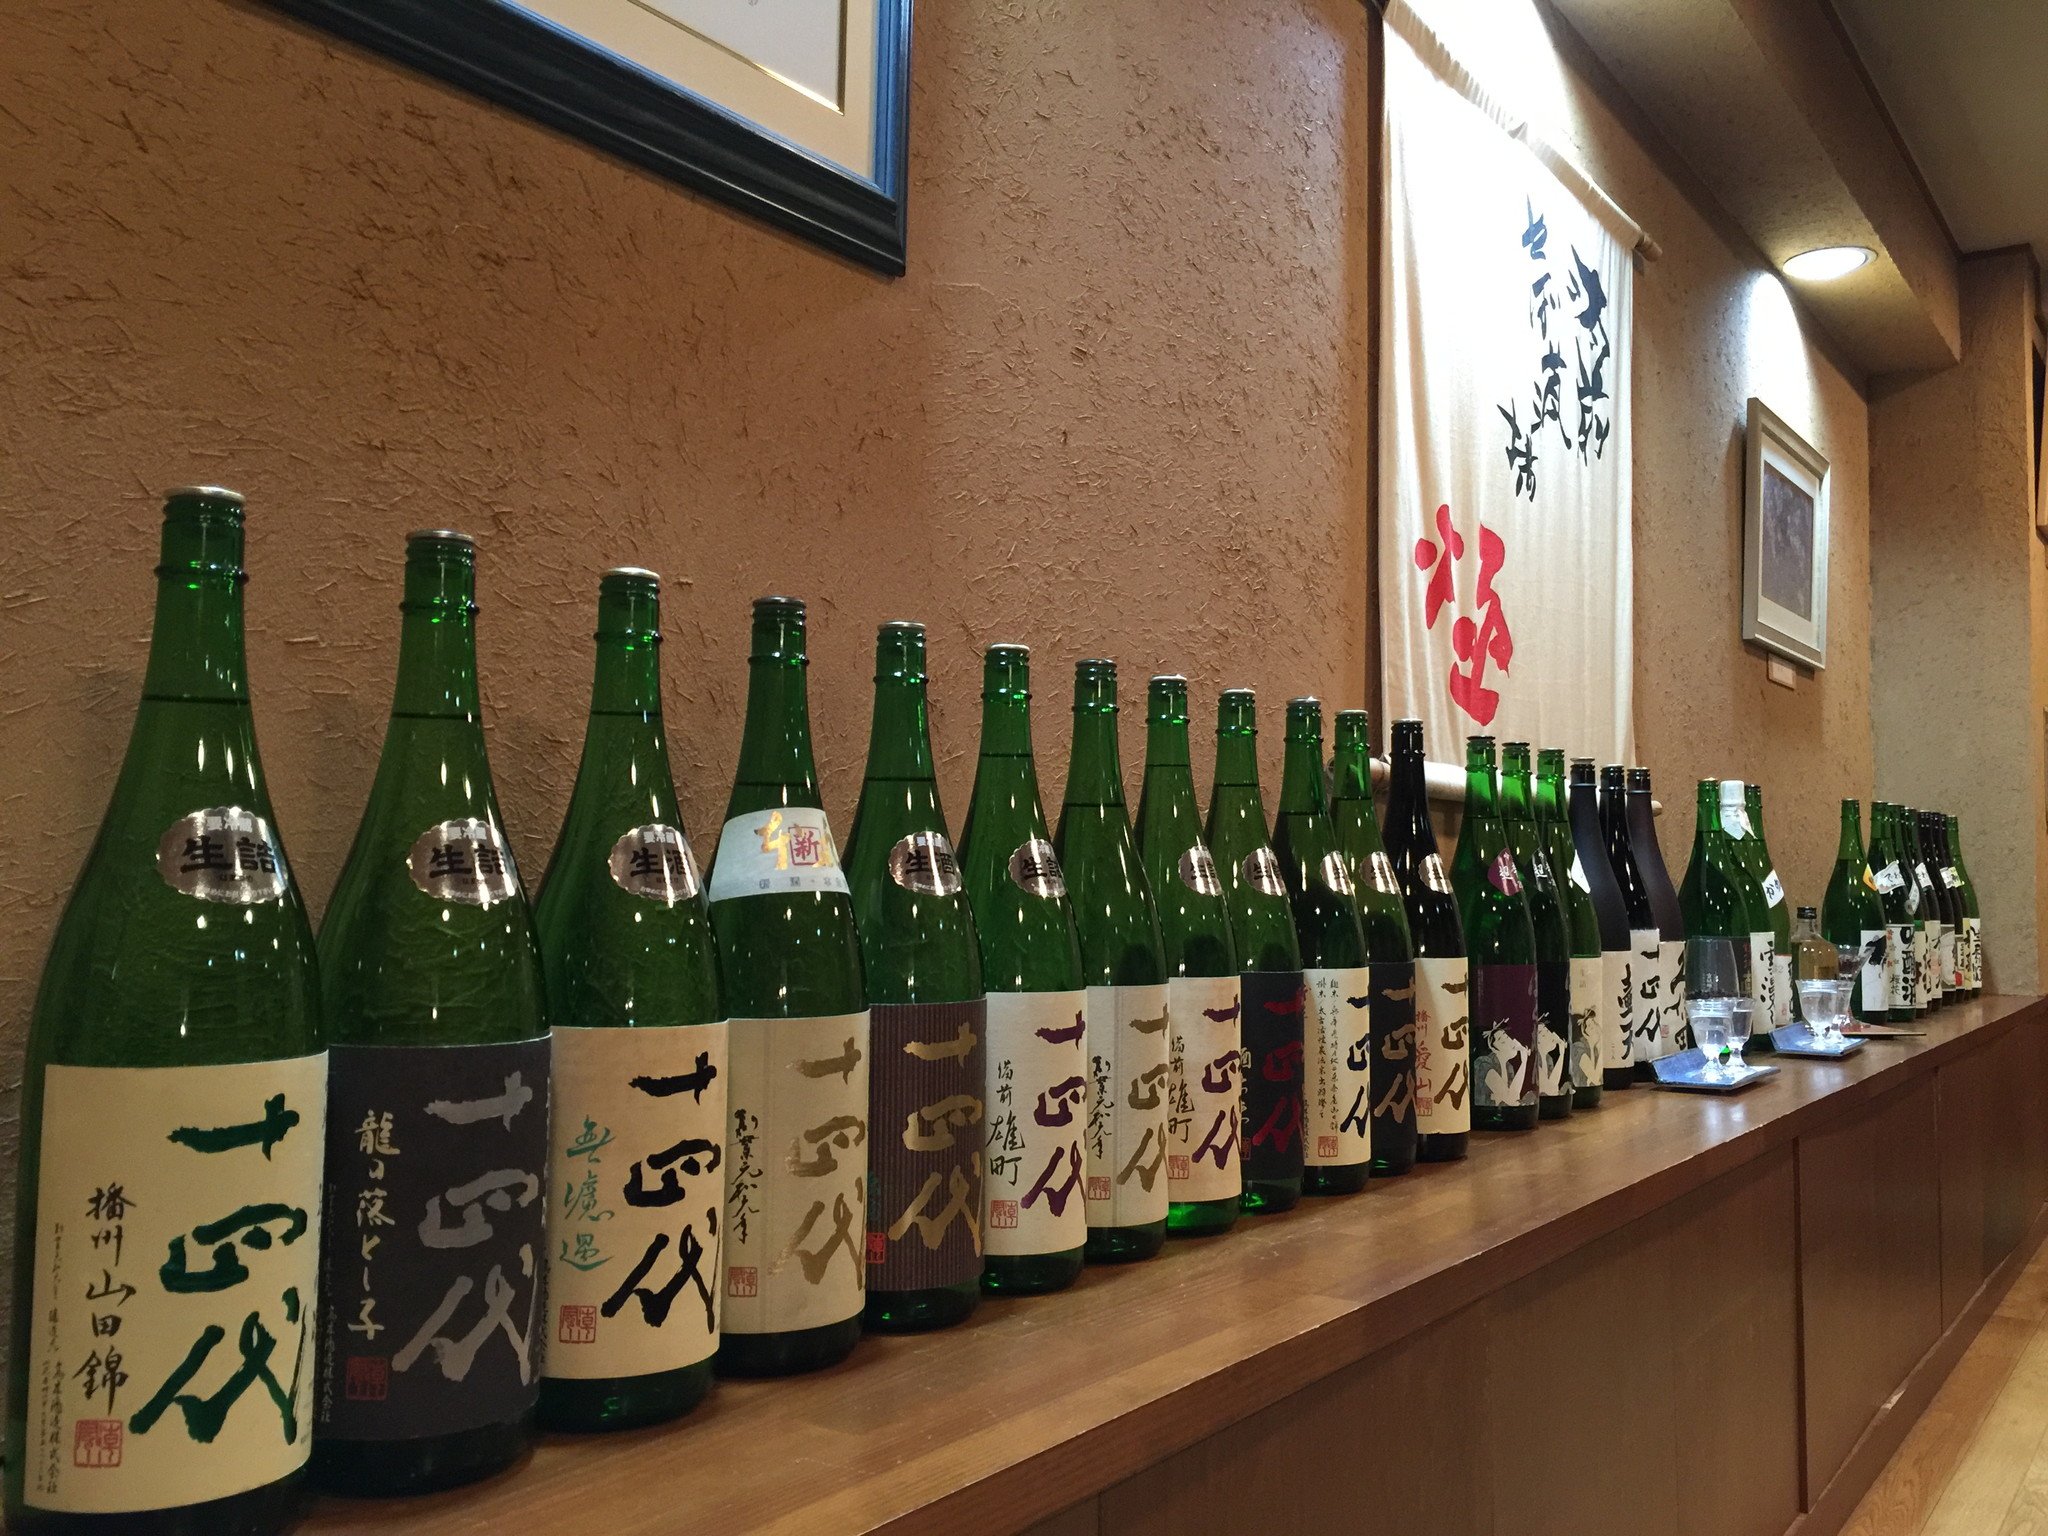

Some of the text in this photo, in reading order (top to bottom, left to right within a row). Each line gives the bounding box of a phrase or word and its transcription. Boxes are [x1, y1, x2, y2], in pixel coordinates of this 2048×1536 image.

[888, 1021, 984, 1259] 十四代
[986, 1059, 1026, 1187] 備前雄町
[1020, 1009, 1088, 1219] 十四代
[1116, 1002, 1169, 1193] 十四代
[1168, 1035, 1195, 1145] 備前雄町
[1191, 994, 1241, 1171] 十四代
[1253, 986, 1305, 1153] 十四代
[1373, 976, 1417, 1126] 十四代
[1415, 1009, 1433, 1093] 播州愛山
[1434, 971, 1470, 1112] 十四代
[348, 1109, 401, 1340] 龍の落とし子
[392, 1070, 539, 1386] 十四代
[601, 1051, 722, 1334] 十四代
[766, 1036, 867, 1292] 十四代
[73, 1181, 138, 1416] 播州山田錦
[129, 1093, 308, 1445] 十四代
